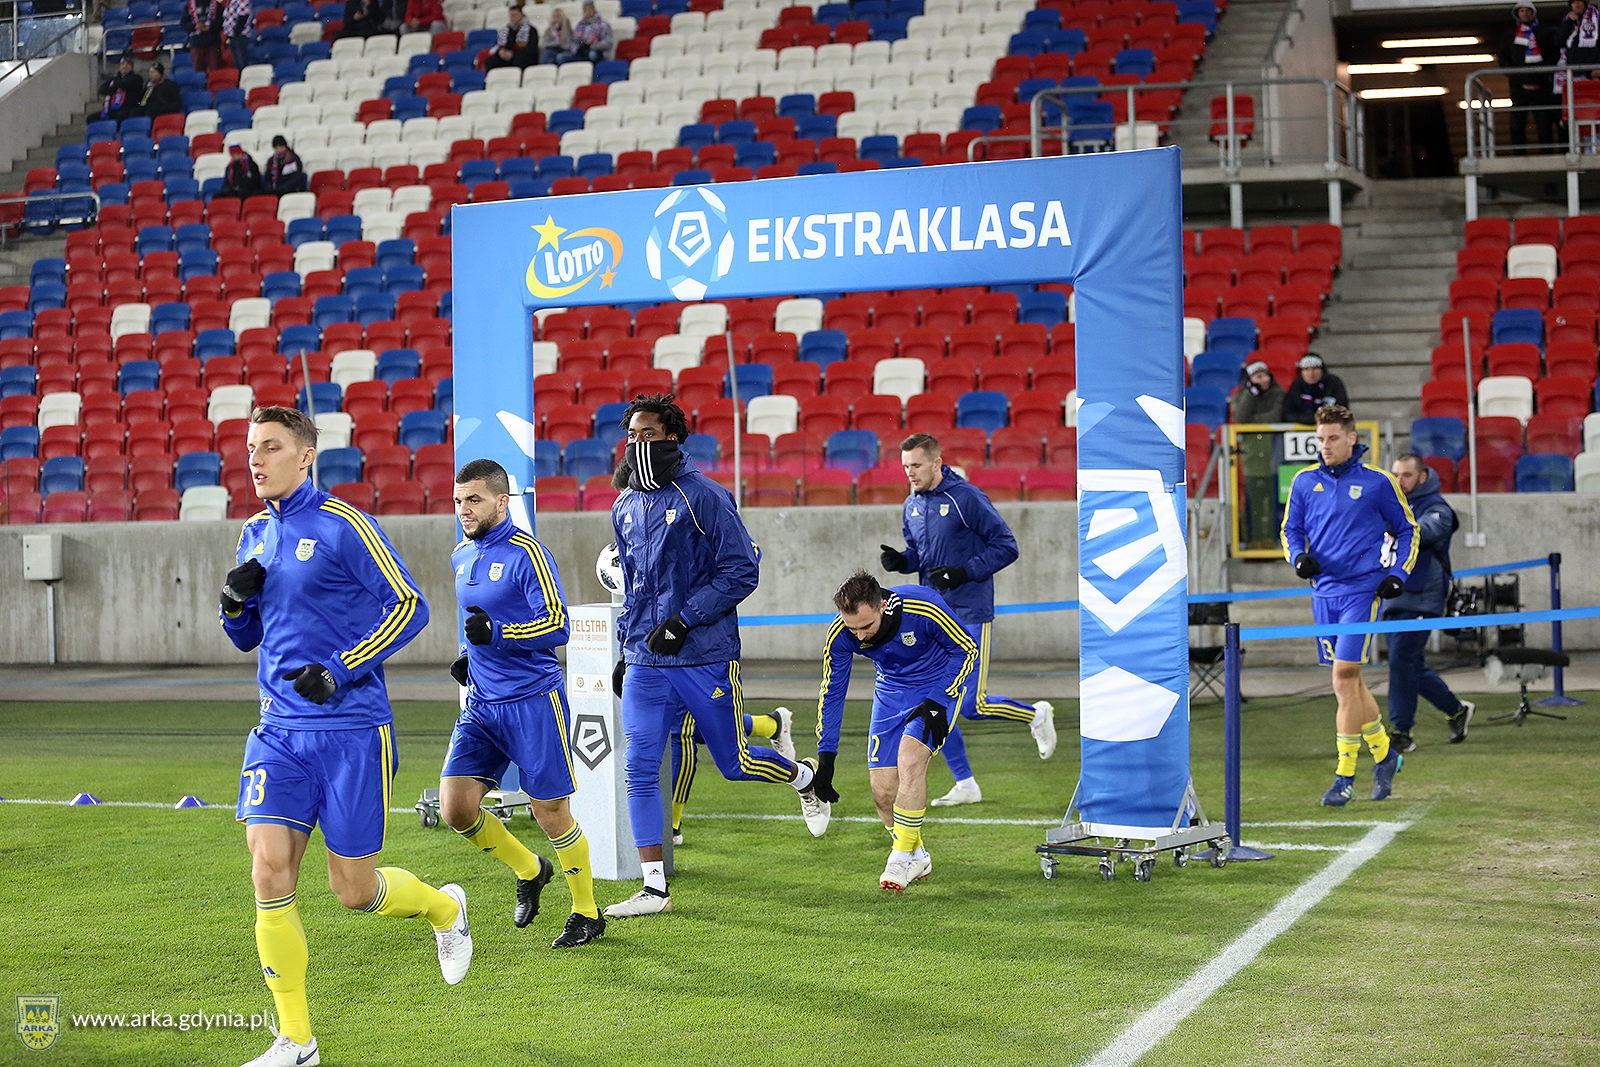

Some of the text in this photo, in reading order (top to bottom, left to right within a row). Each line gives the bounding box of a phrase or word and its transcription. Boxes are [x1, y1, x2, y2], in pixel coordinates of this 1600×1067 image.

[748, 200, 1072, 263] EKSTRAKLASA
[544, 240, 604, 284] LOTTO
[242, 768, 267, 807] 33
